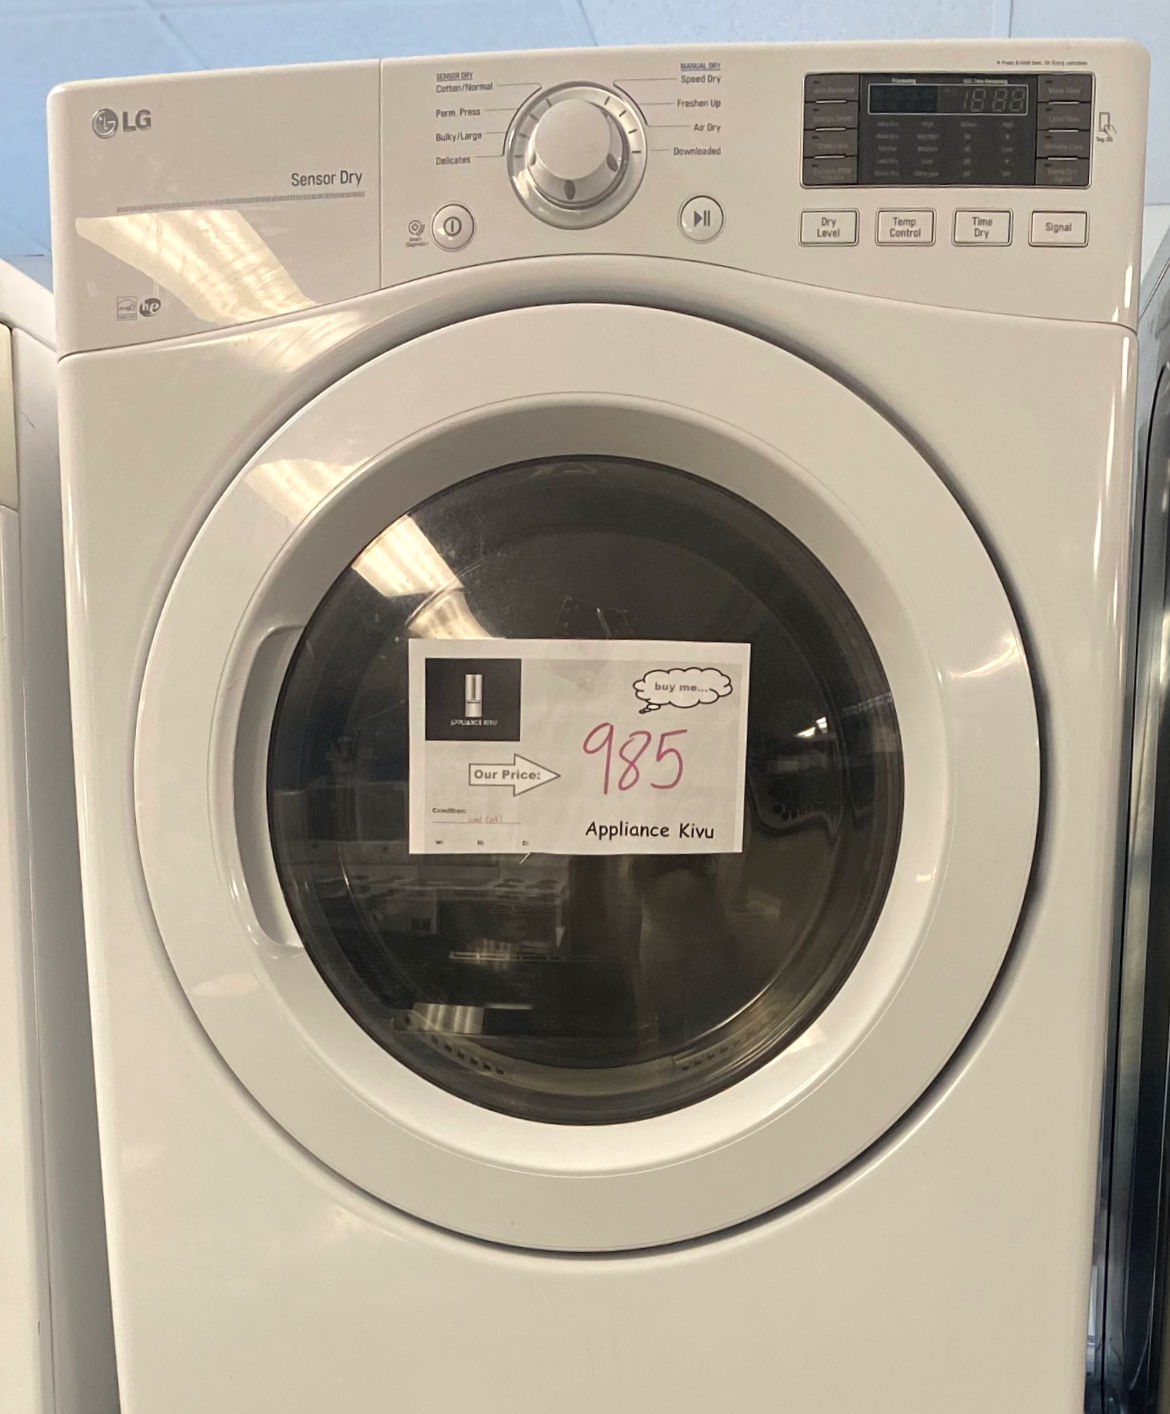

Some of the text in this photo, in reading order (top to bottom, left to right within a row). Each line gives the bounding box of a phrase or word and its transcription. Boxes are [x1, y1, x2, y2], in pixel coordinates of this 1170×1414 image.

[681, 74, 721, 84] Speed Dry
[436, 82, 493, 93] Cotton/Normal
[677, 99, 721, 108] Freshen Up
[459, 107, 480, 117] Press
[122, 109, 152, 132] LG
[694, 123, 721, 133] Air Dry
[436, 132, 482, 142] Bulky/Large
[673, 147, 721, 156] Downloaded
[436, 156, 470, 165] Delicates
[291, 170, 363, 187] Sensor Dry
[821, 217, 837, 228] Dry
[893, 217, 916, 227] Temp
[972, 216, 993, 226] Time
[1045, 222, 1072, 233] Signal
[817, 228, 840, 238] Level
[889, 228, 921, 238] Control
[974, 228, 989, 239] Dry
[655, 682, 708, 693] buy me...
[582, 721, 688, 795] 985
[474, 769, 541, 780] Our Price:
[585, 820, 714, 840] Appliance Kivu
